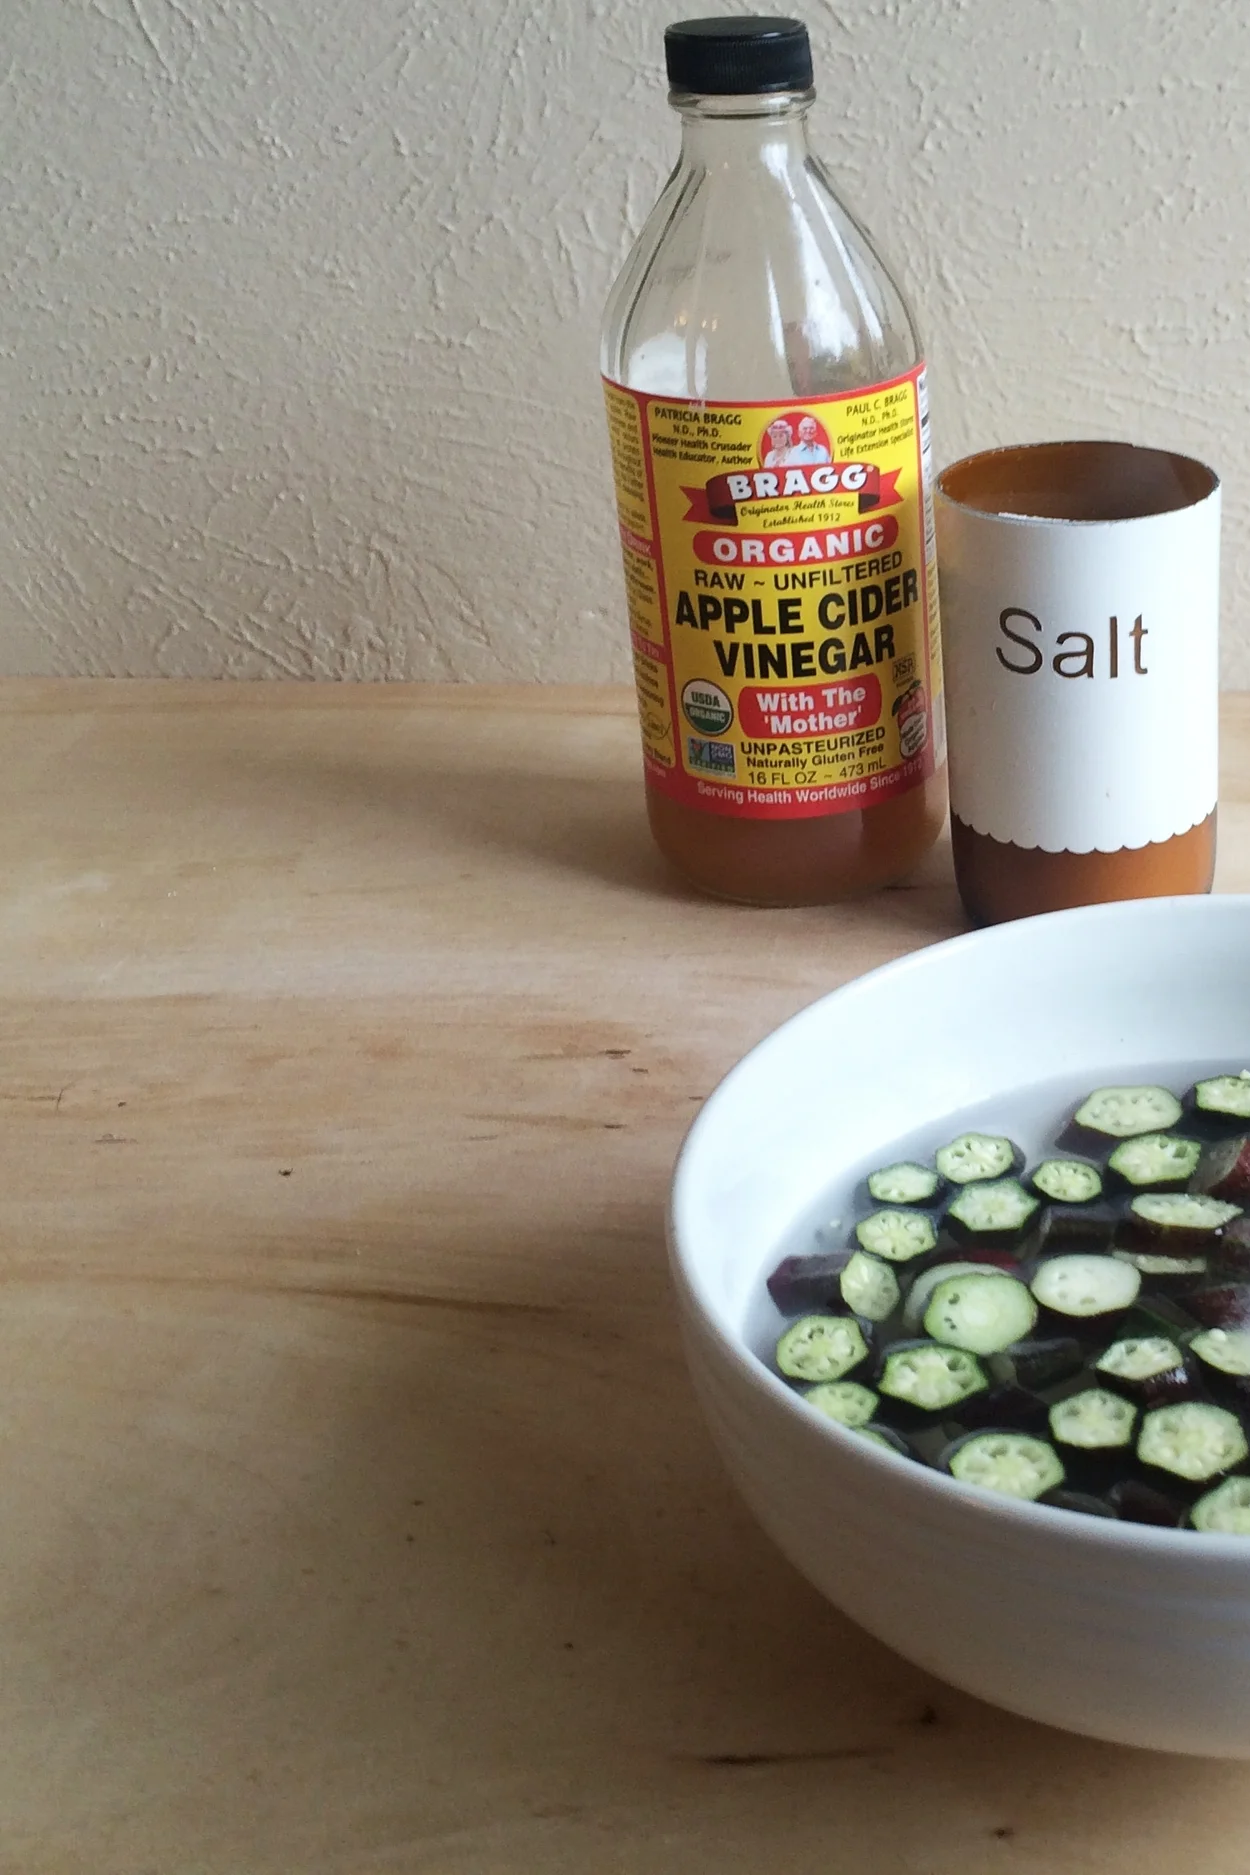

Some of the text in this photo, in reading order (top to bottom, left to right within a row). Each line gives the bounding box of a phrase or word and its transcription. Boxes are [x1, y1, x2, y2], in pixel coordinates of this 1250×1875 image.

[654, 407, 742, 425] PATRICIA BRAGG
[846, 403, 871, 417] PAUL
[884, 389, 907, 408] BRAGG
[711, 441, 752, 452] Crusader
[837, 429, 877, 445] Originator
[840, 445, 854, 458] Life
[856, 436, 889, 455] Extension
[721, 455, 753, 466] Author
[727, 464, 867, 500] BRAGG
[740, 498, 855, 517] Originator Health Stores
[763, 512, 841, 528] Established 1912
[713, 524, 884, 563] ORGANIC
[694, 568, 745, 590] RAW
[774, 550, 903, 590] UNFILTERED
[675, 591, 805, 635] APPLE
[818, 568, 919, 630] CIDER
[713, 624, 896, 679] VINEGAR
[995, 607, 1149, 679] Salt
[691, 691, 720, 708] USDA
[756, 687, 866, 712] With The
[689, 706, 726, 723] ORGANIC
[764, 705, 862, 734] 'Mother'
[741, 726, 885, 755] UNPASTEURIZED
[746, 756, 807, 769] Naturally
[811, 751, 855, 767] Gluten
[859, 743, 884, 758] Free
[749, 771, 767, 785] 16
[771, 772, 790, 785] FL
[795, 771, 817, 784] OZ
[839, 764, 864, 778] 473
[867, 757, 887, 773] mL
[697, 781, 744, 804] Serving
[747, 789, 792, 804] Health
[797, 783, 866, 804] Worldwide
[870, 774, 901, 791] Since
